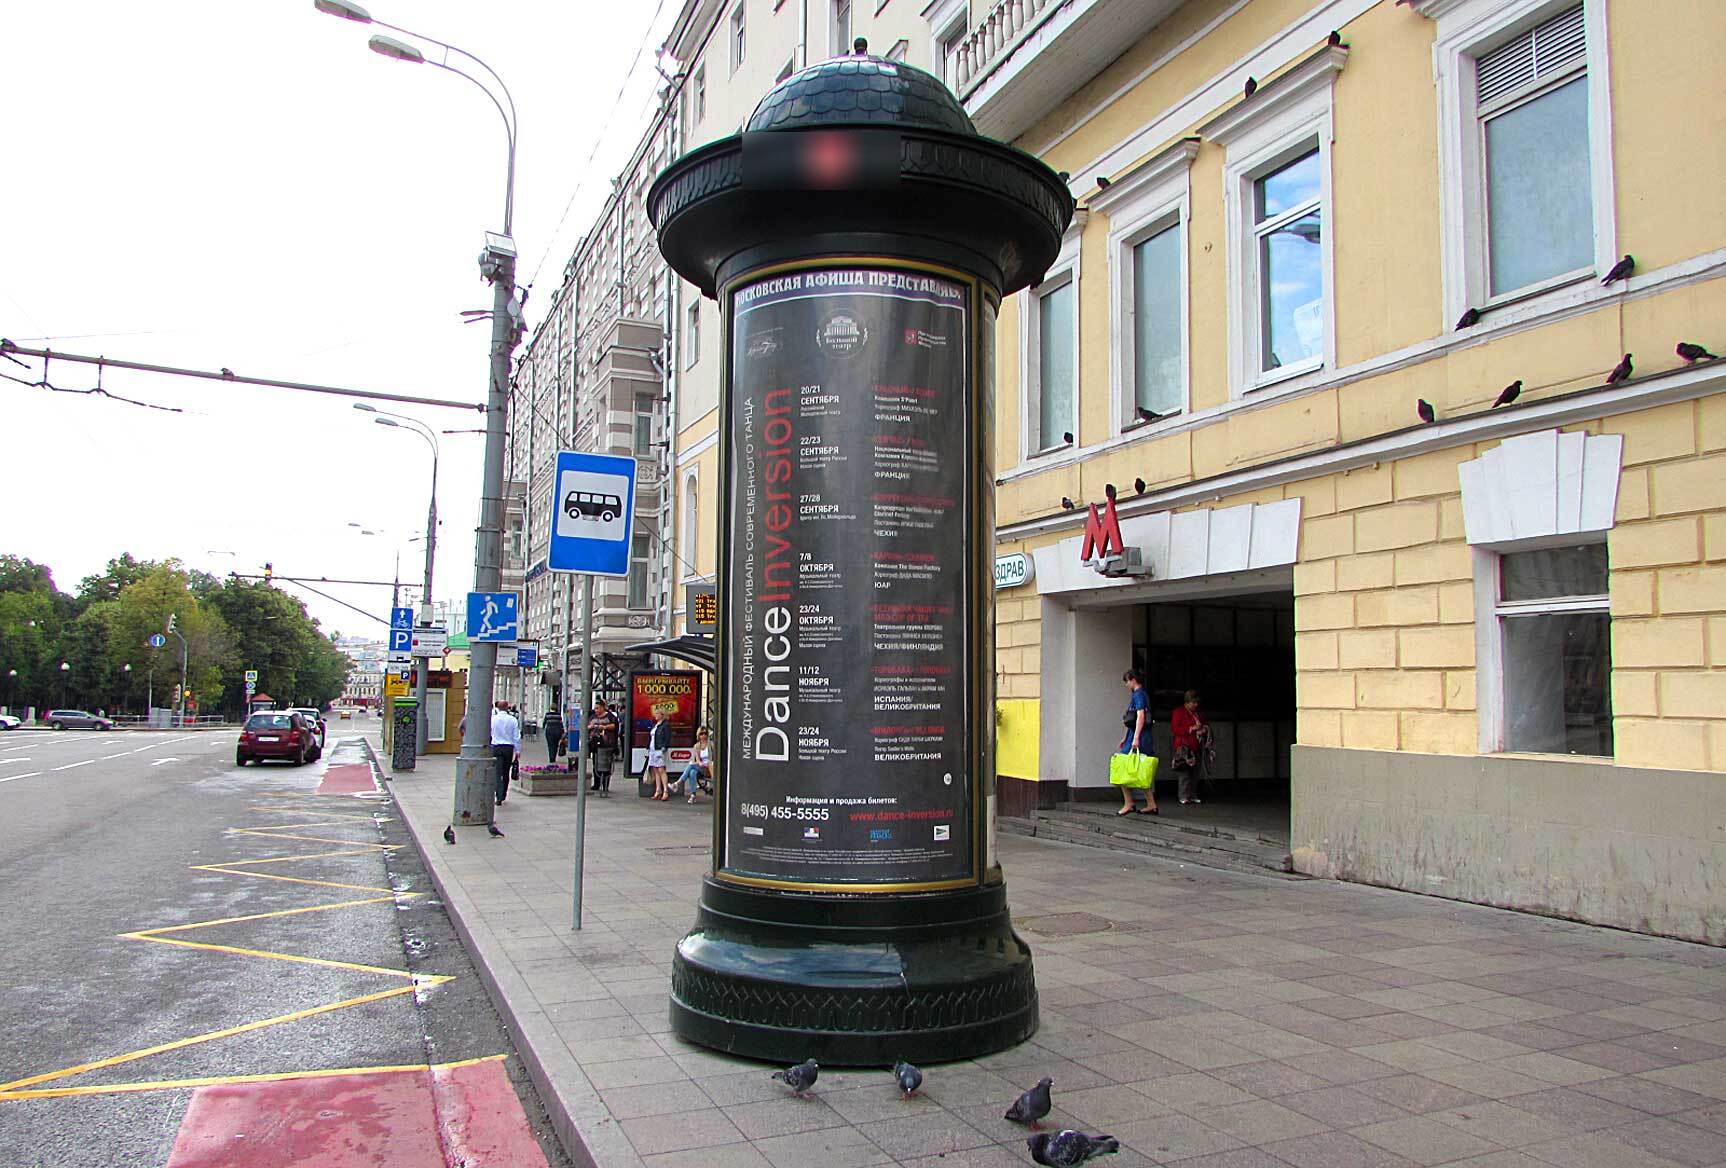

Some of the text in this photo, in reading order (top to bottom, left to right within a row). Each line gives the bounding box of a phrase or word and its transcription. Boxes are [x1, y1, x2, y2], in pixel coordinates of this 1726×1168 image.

[735, 276, 802, 307] МОСКОВСКАЯ
[806, 272, 865, 288] АФИША
[801, 386, 821, 394] 20/21
[801, 395, 840, 405] СЕНТЯБРЯ
[875, 414, 911, 422] ФРАНЦИЯ
[801, 436, 821, 445] 22/23
[800, 446, 839, 456] СЕНТЯБРЯ
[800, 494, 820, 503] 27/28
[800, 504, 839, 514] СЕНТЯБРЯ
[874, 529, 897, 537] ЧЕХИЯ
[1081, 498, 1125, 561] М
[800, 553, 812, 561] 7/8
[800, 563, 834, 573] ОКТЯБРЯ
[742, 396, 757, 760] МЕЖДУНАРОДНЫЙ ФЕСТИВАЛЬ СОВРЕМЕННОГО ТАНЦА
[800, 605, 820, 613] 23/24
[799, 616, 834, 625] ОКТЯБРЯ
[395, 632, 408, 649] P
[874, 643, 944, 652] ЧЕХИЯ/ФИНЛЯНДИЯ
[402, 671, 409, 679] P
[799, 666, 820, 675] 11/12
[799, 678, 830, 687] НОЯБРЯ
[874, 703, 941, 711] ВЕЛИКОБРИТАНИЯ
[799, 727, 819, 735] 23/24
[799, 738, 830, 747] НОЯБРЯ
[874, 753, 942, 761] ВЕЛИКОБРИТАНИЯ
[786, 796, 829, 805] Информация
[741, 803, 830, 821] 8(495) 455-5555
